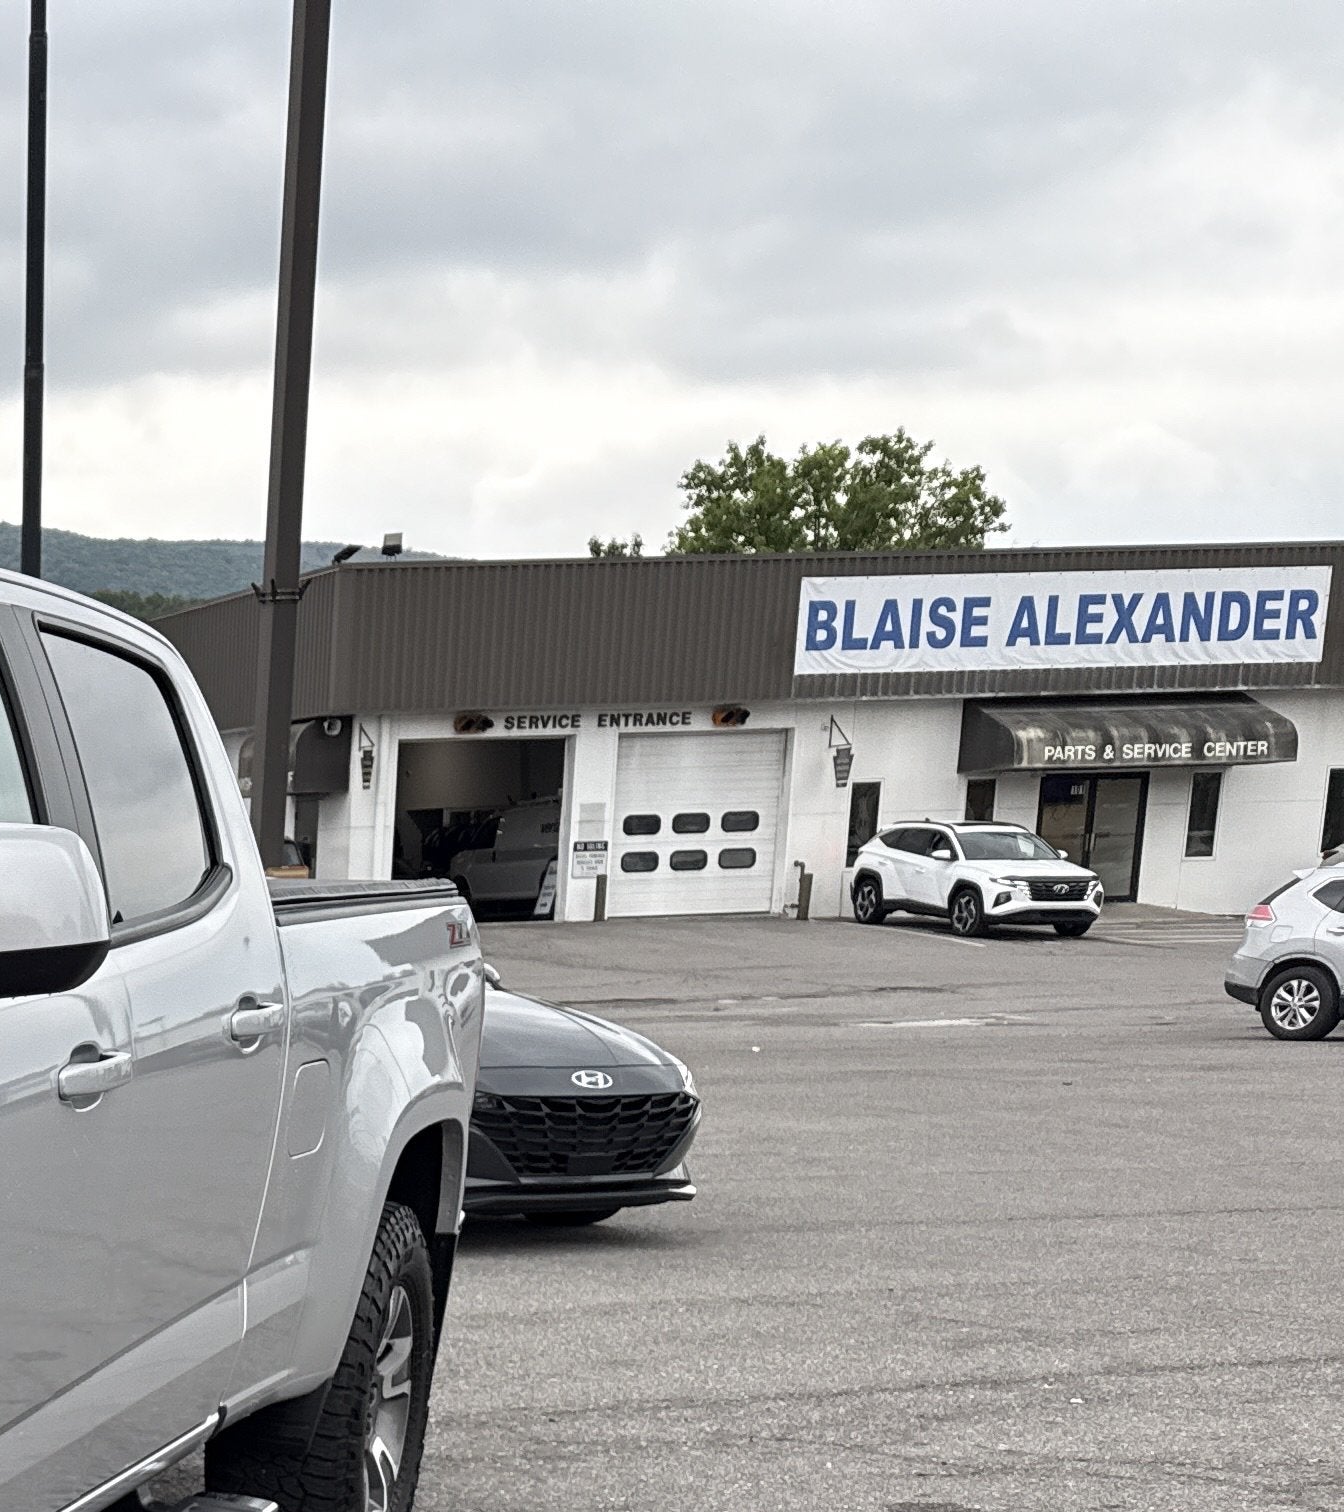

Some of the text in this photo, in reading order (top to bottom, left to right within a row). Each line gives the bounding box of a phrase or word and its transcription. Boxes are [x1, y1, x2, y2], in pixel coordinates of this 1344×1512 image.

[805, 589, 1319, 651] BLAISE ALEXANDER
[504, 711, 693, 730] SERVICE ENTRANCE
[1044, 740, 1269, 761] PARTS & SERVICE CENTER
